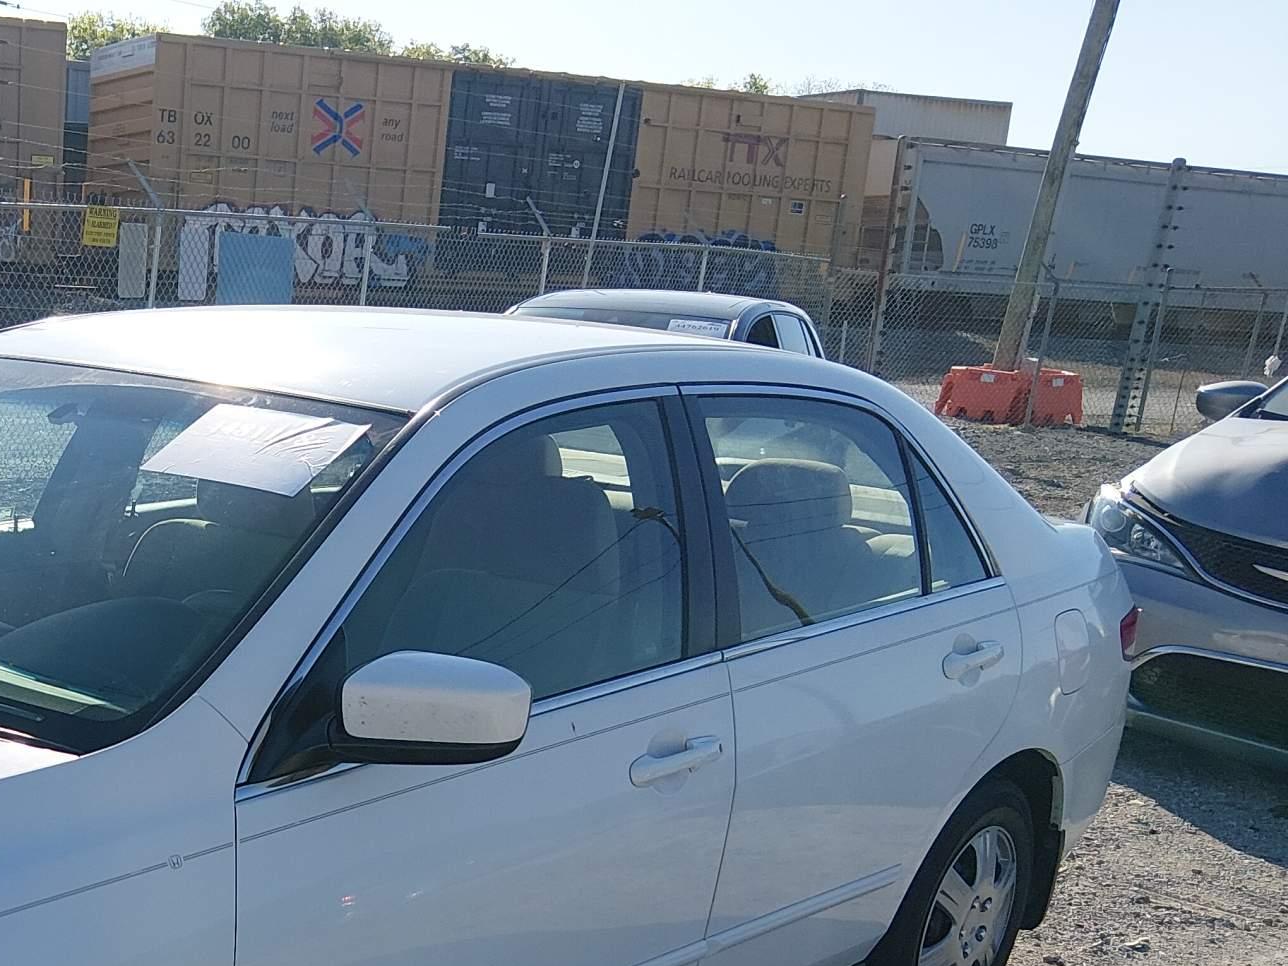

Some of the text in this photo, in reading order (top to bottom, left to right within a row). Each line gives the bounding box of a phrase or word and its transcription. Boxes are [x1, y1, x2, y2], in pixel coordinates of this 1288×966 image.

[159, 108, 214, 126] TB OX
[272, 110, 295, 121] next
[270, 121, 294, 134] load
[382, 117, 401, 130] any
[156, 129, 251, 150] 63 22 00
[381, 132, 404, 142] road
[88, 207, 117, 218] WARNING
[970, 223, 996, 236] GPLX
